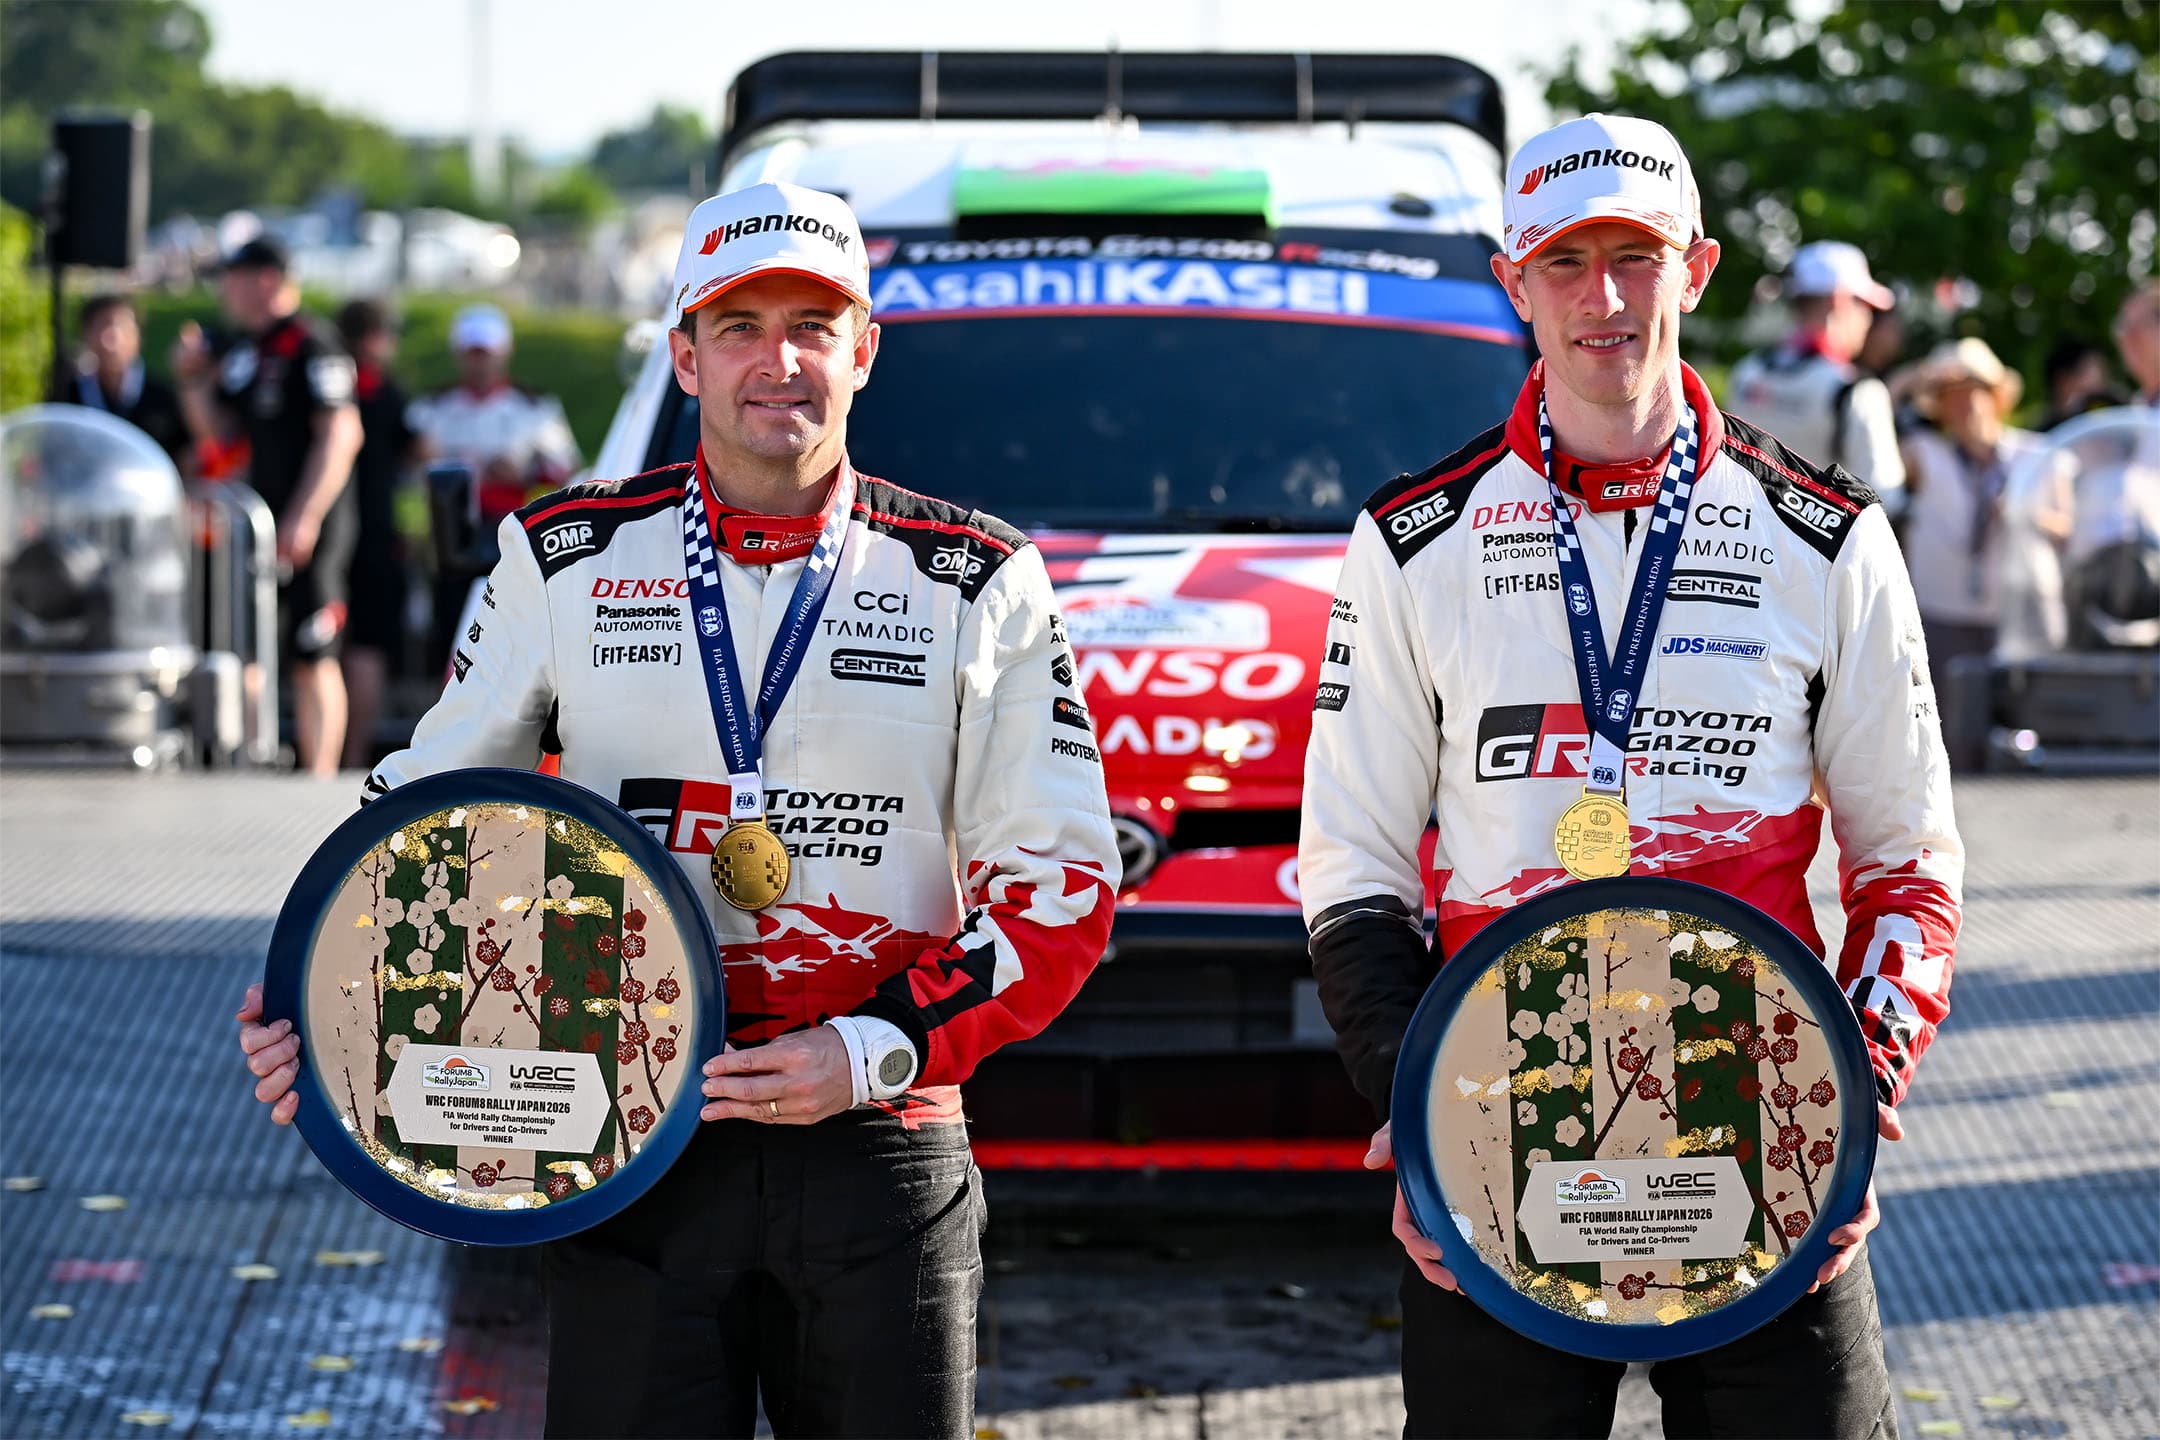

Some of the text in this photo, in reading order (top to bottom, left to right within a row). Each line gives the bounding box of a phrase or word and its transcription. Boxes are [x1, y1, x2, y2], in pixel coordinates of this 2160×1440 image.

[1279, 242, 1440, 280] Racing
[1603, 485, 1642, 496] GR
[1391, 497, 1449, 534] OMP
[1783, 491, 1841, 529] OMP
[543, 526, 593, 553] OMP
[742, 538, 780, 551] GR
[1483, 532, 1555, 548] Panason
[1482, 547, 1554, 563] AUTOMOT
[1678, 539, 1774, 564] AMADIC
[932, 552, 981, 577] OMP
[596, 604, 681, 619] Panasonic
[1624, 555, 1663, 674] FIA PRESIDENT'S MEDAL
[594, 620, 682, 632] AUTOMOTIVE
[823, 619, 934, 643] TAMADIC
[762, 591, 816, 701] FIA PRESIDENT'S MEDAL
[1583, 630, 1592, 647] FIA
[1662, 637, 1766, 656] JDS MACHINERY
[831, 658, 926, 676] CENTRAL
[1081, 651, 1306, 699] NSO
[712, 648, 746, 770] FIA PRESIDENT'S MEDAL
[1633, 707, 1772, 733] TOYOTA
[1100, 714, 1277, 759] ADIC
[1626, 732, 1756, 757] GAZOO
[1479, 734, 1590, 778] GR
[1594, 768, 1614, 782] FIA
[1625, 756, 1748, 787] Racing
[736, 794, 755, 807] FIA
[763, 789, 903, 813] TOYOTA
[789, 837, 882, 866] acing
[440, 1068, 472, 1077] FORUM8
[510, 1064, 575, 1082] WRC
[426, 1095, 571, 1114] WRC FORUM8 RALLY JAPAN 2026
[443, 1111, 555, 1126] FIA World Rally Championship
[450, 1122, 548, 1135] for Drivers and Co-Drivers
[483, 1134, 514, 1144] WINNER
[1574, 1183, 1608, 1191] FORUM8
[1647, 1172, 1716, 1189] WRC
[1560, 1208, 1713, 1224] WRC FORUM8 RALLY JAPAN 2026
[1579, 1224, 1698, 1235] FIA World Rally Championship
[1587, 1235, 1690, 1246] for Drivers and Co-Drivers
[1623, 1247, 1655, 1255] WINNER
